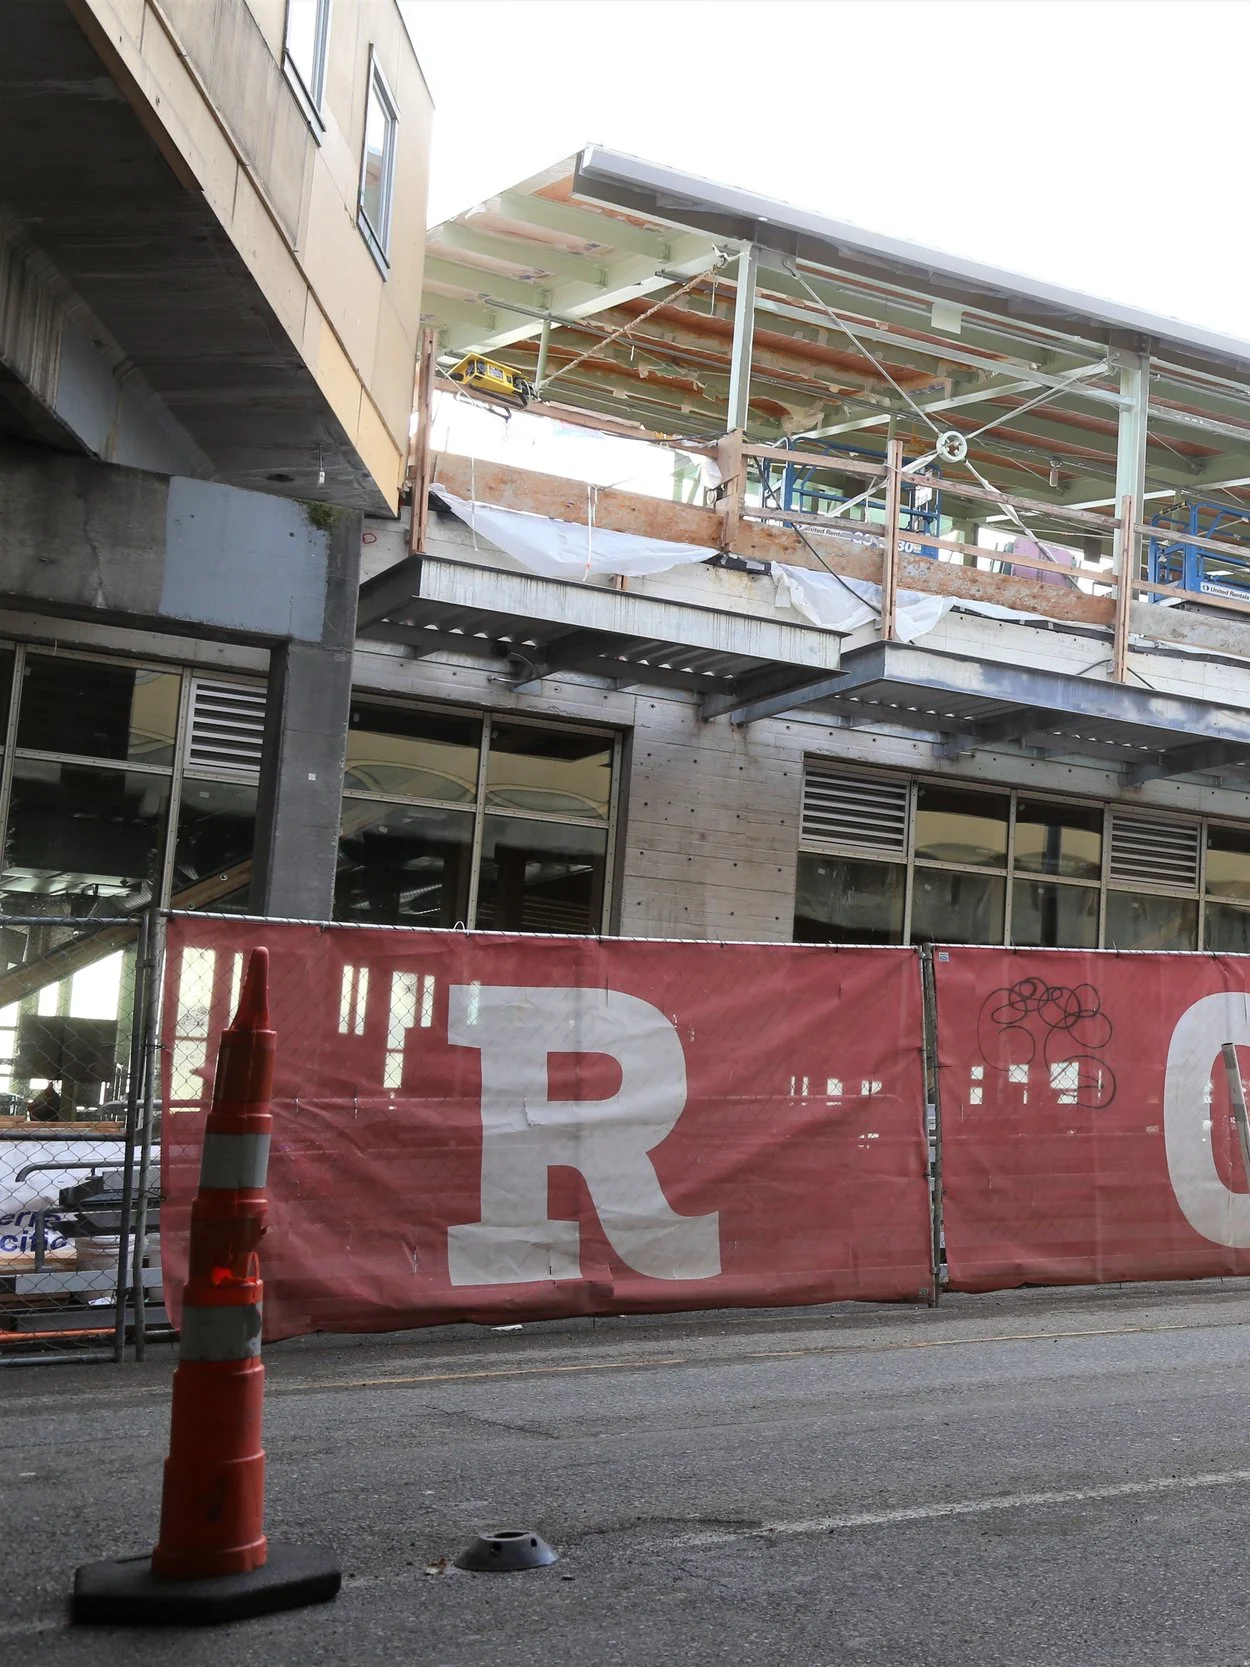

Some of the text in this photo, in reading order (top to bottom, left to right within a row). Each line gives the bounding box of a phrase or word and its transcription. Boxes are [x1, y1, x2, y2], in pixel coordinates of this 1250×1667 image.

[1210, 586, 1250, 601] United Rentals
[448, 984, 721, 1286] R
